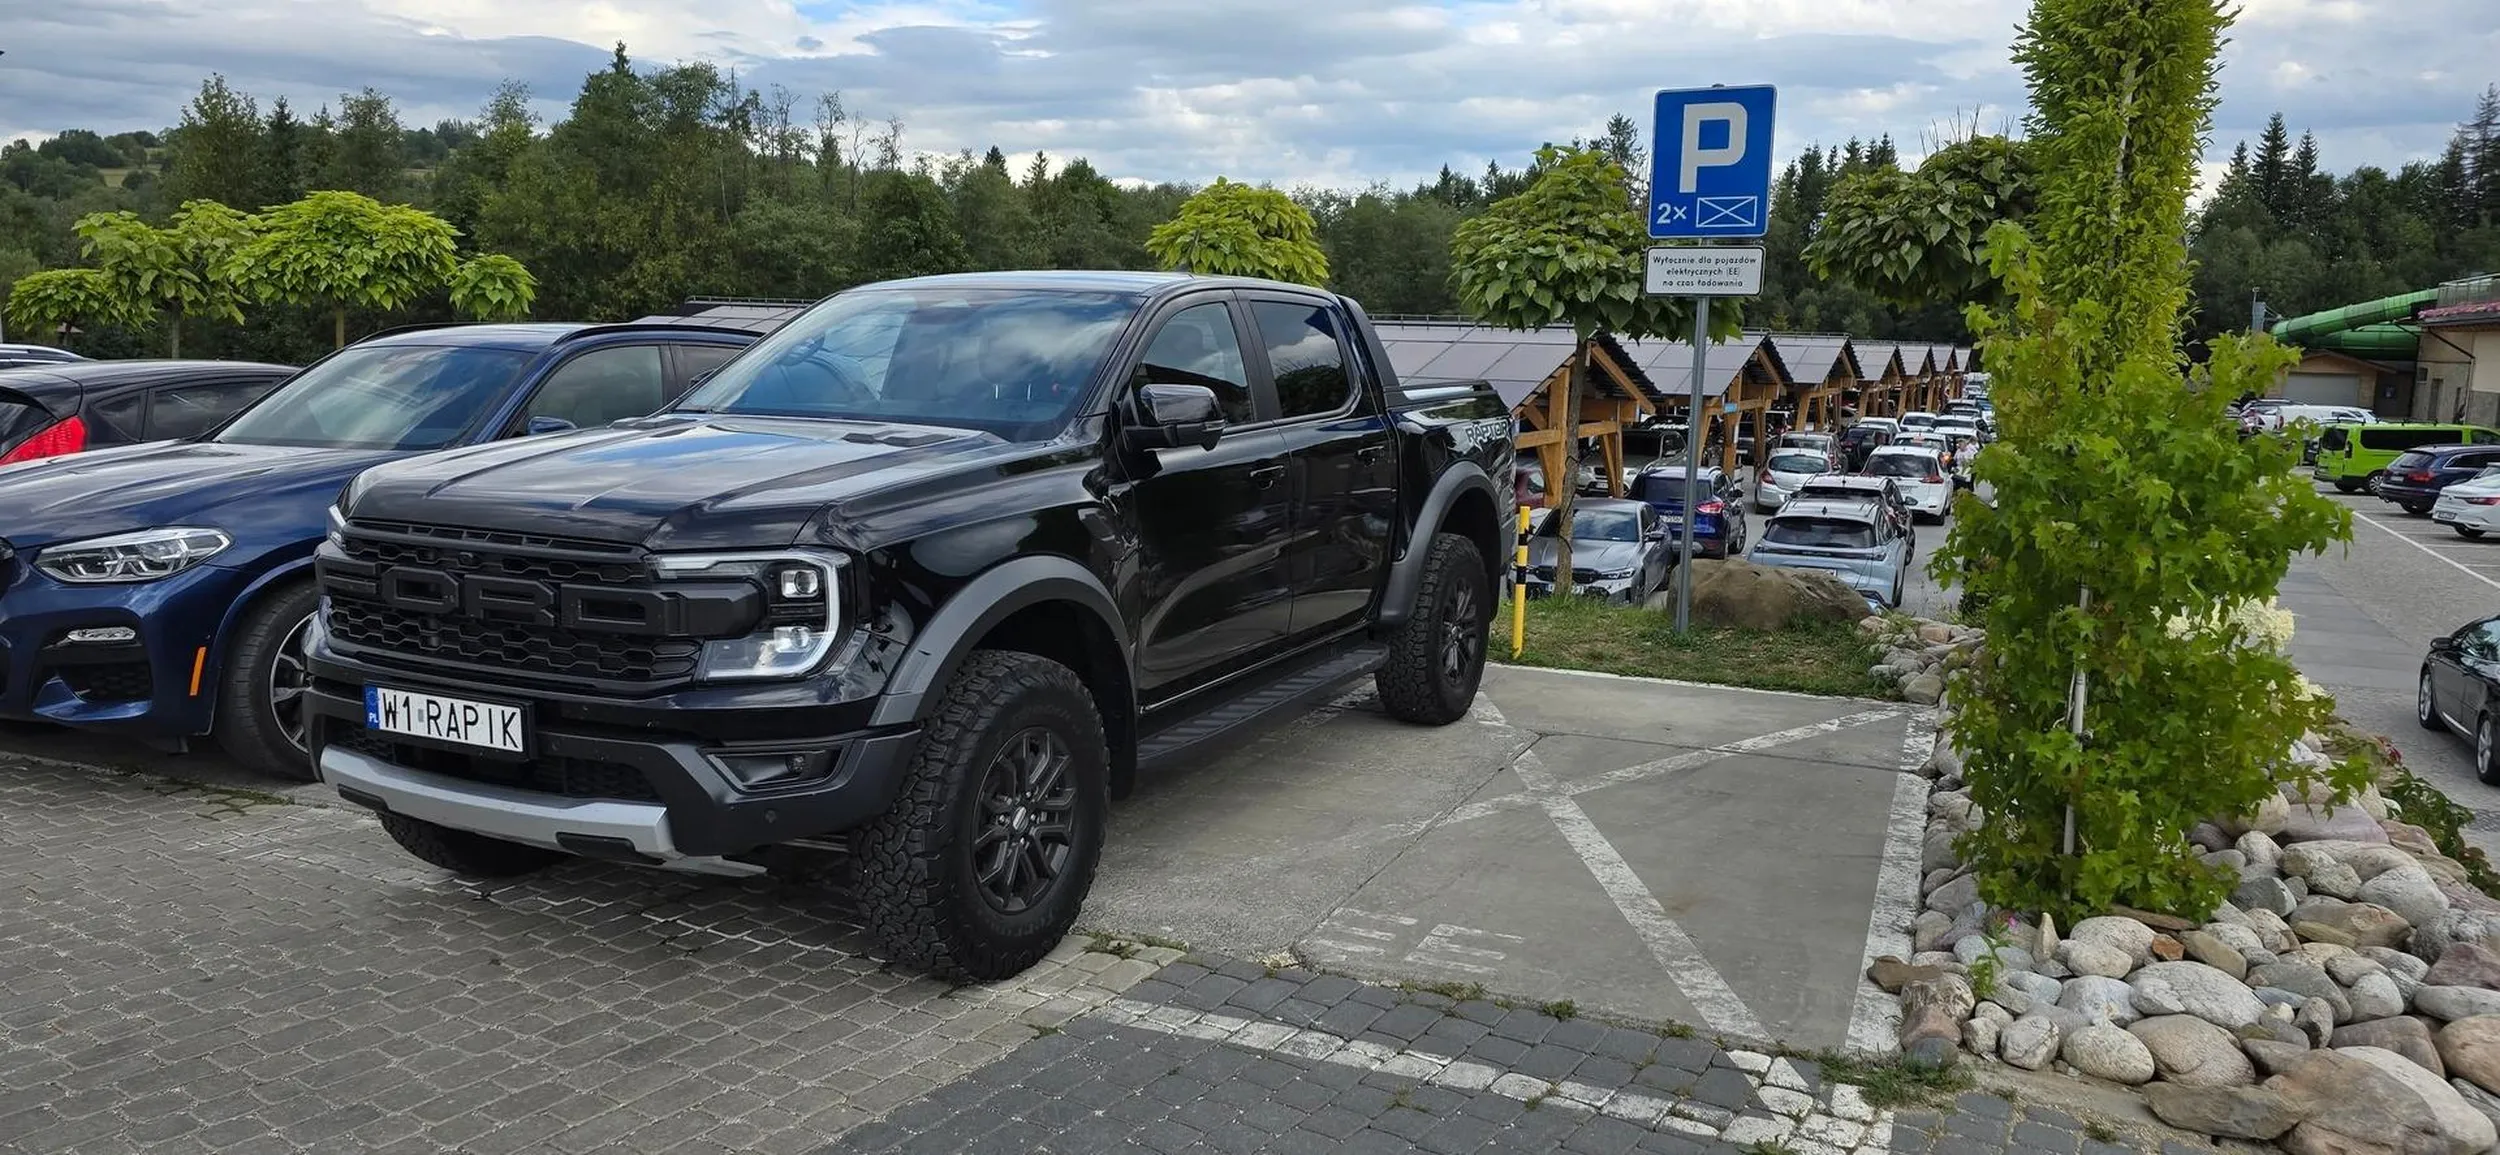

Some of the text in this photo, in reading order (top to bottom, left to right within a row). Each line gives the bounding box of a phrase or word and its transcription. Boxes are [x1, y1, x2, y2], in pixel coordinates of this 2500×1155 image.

[1679, 102, 1748, 193] P
[1666, 267, 1723, 276] elektrycznych
[1698, 256, 1711, 264] dla
[1715, 256, 1757, 265] pojazdów
[1465, 421, 1509, 443] RAPTOR
[315, 556, 682, 636] FORD
[382, 693, 520, 749] W1 RAPIK
